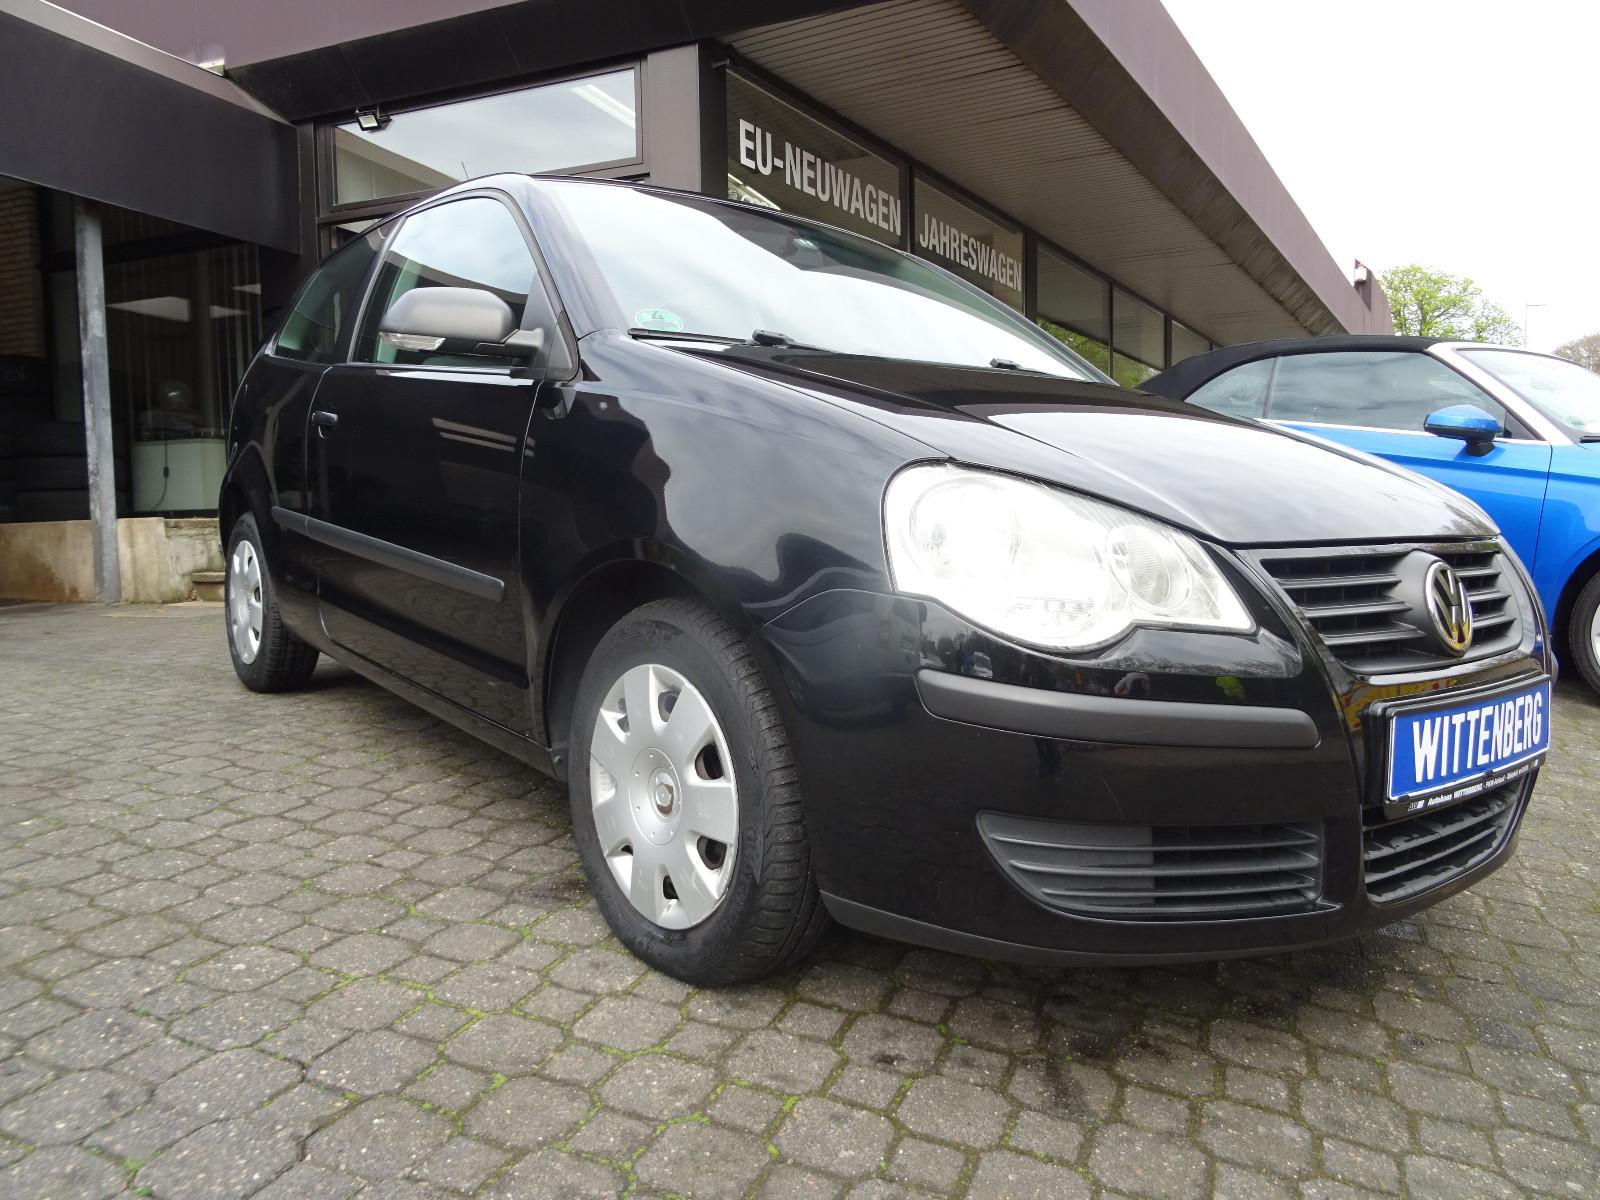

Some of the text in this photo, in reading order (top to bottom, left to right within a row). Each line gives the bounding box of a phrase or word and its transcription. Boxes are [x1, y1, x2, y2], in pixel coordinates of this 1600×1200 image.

[739, 118, 901, 236] EU-NEUWAGEN
[919, 213, 1022, 292] JAHRESWAGEN
[1412, 691, 1543, 783] WITTENBERG
